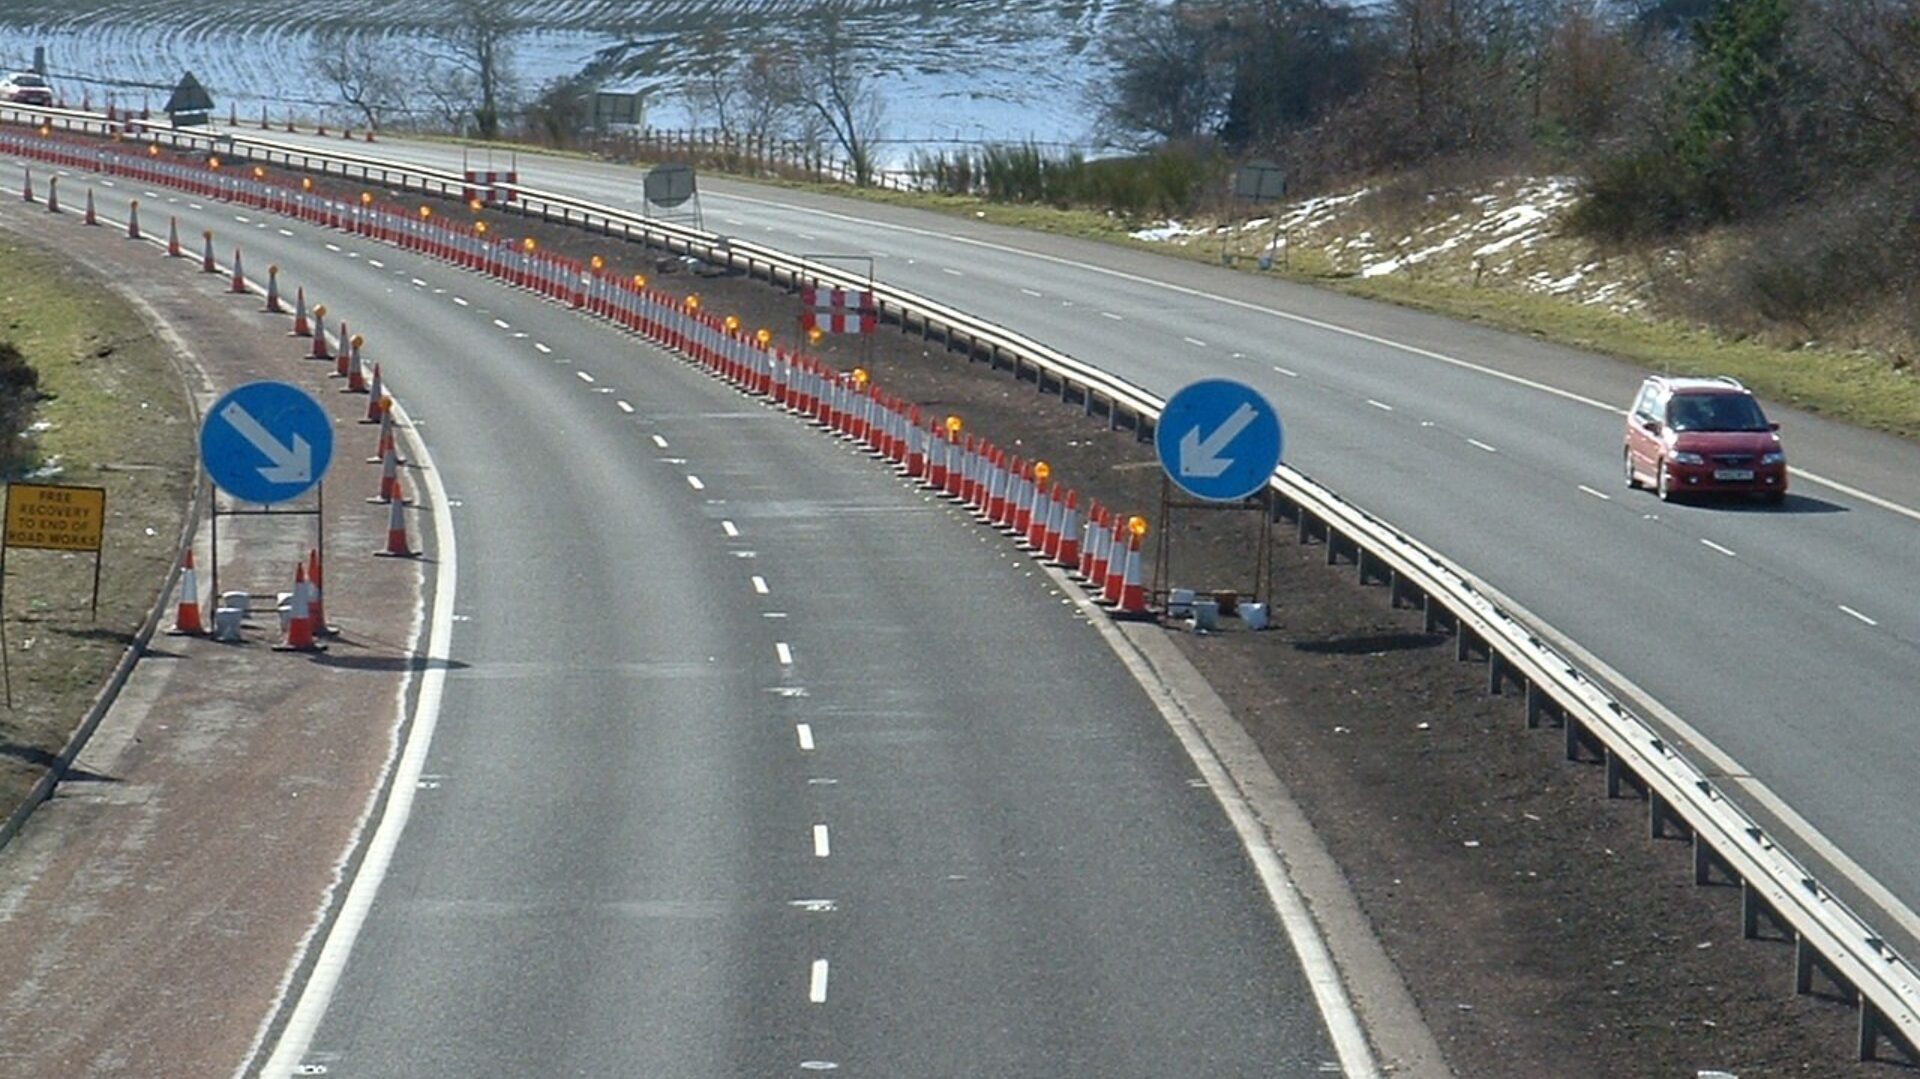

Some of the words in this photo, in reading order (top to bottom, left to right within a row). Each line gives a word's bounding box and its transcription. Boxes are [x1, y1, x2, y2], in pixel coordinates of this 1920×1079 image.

[39, 490, 70, 503] FREE
[19, 517, 35, 528] TO
[41, 519, 67, 530] END
[9, 530, 44, 542] ROAD
